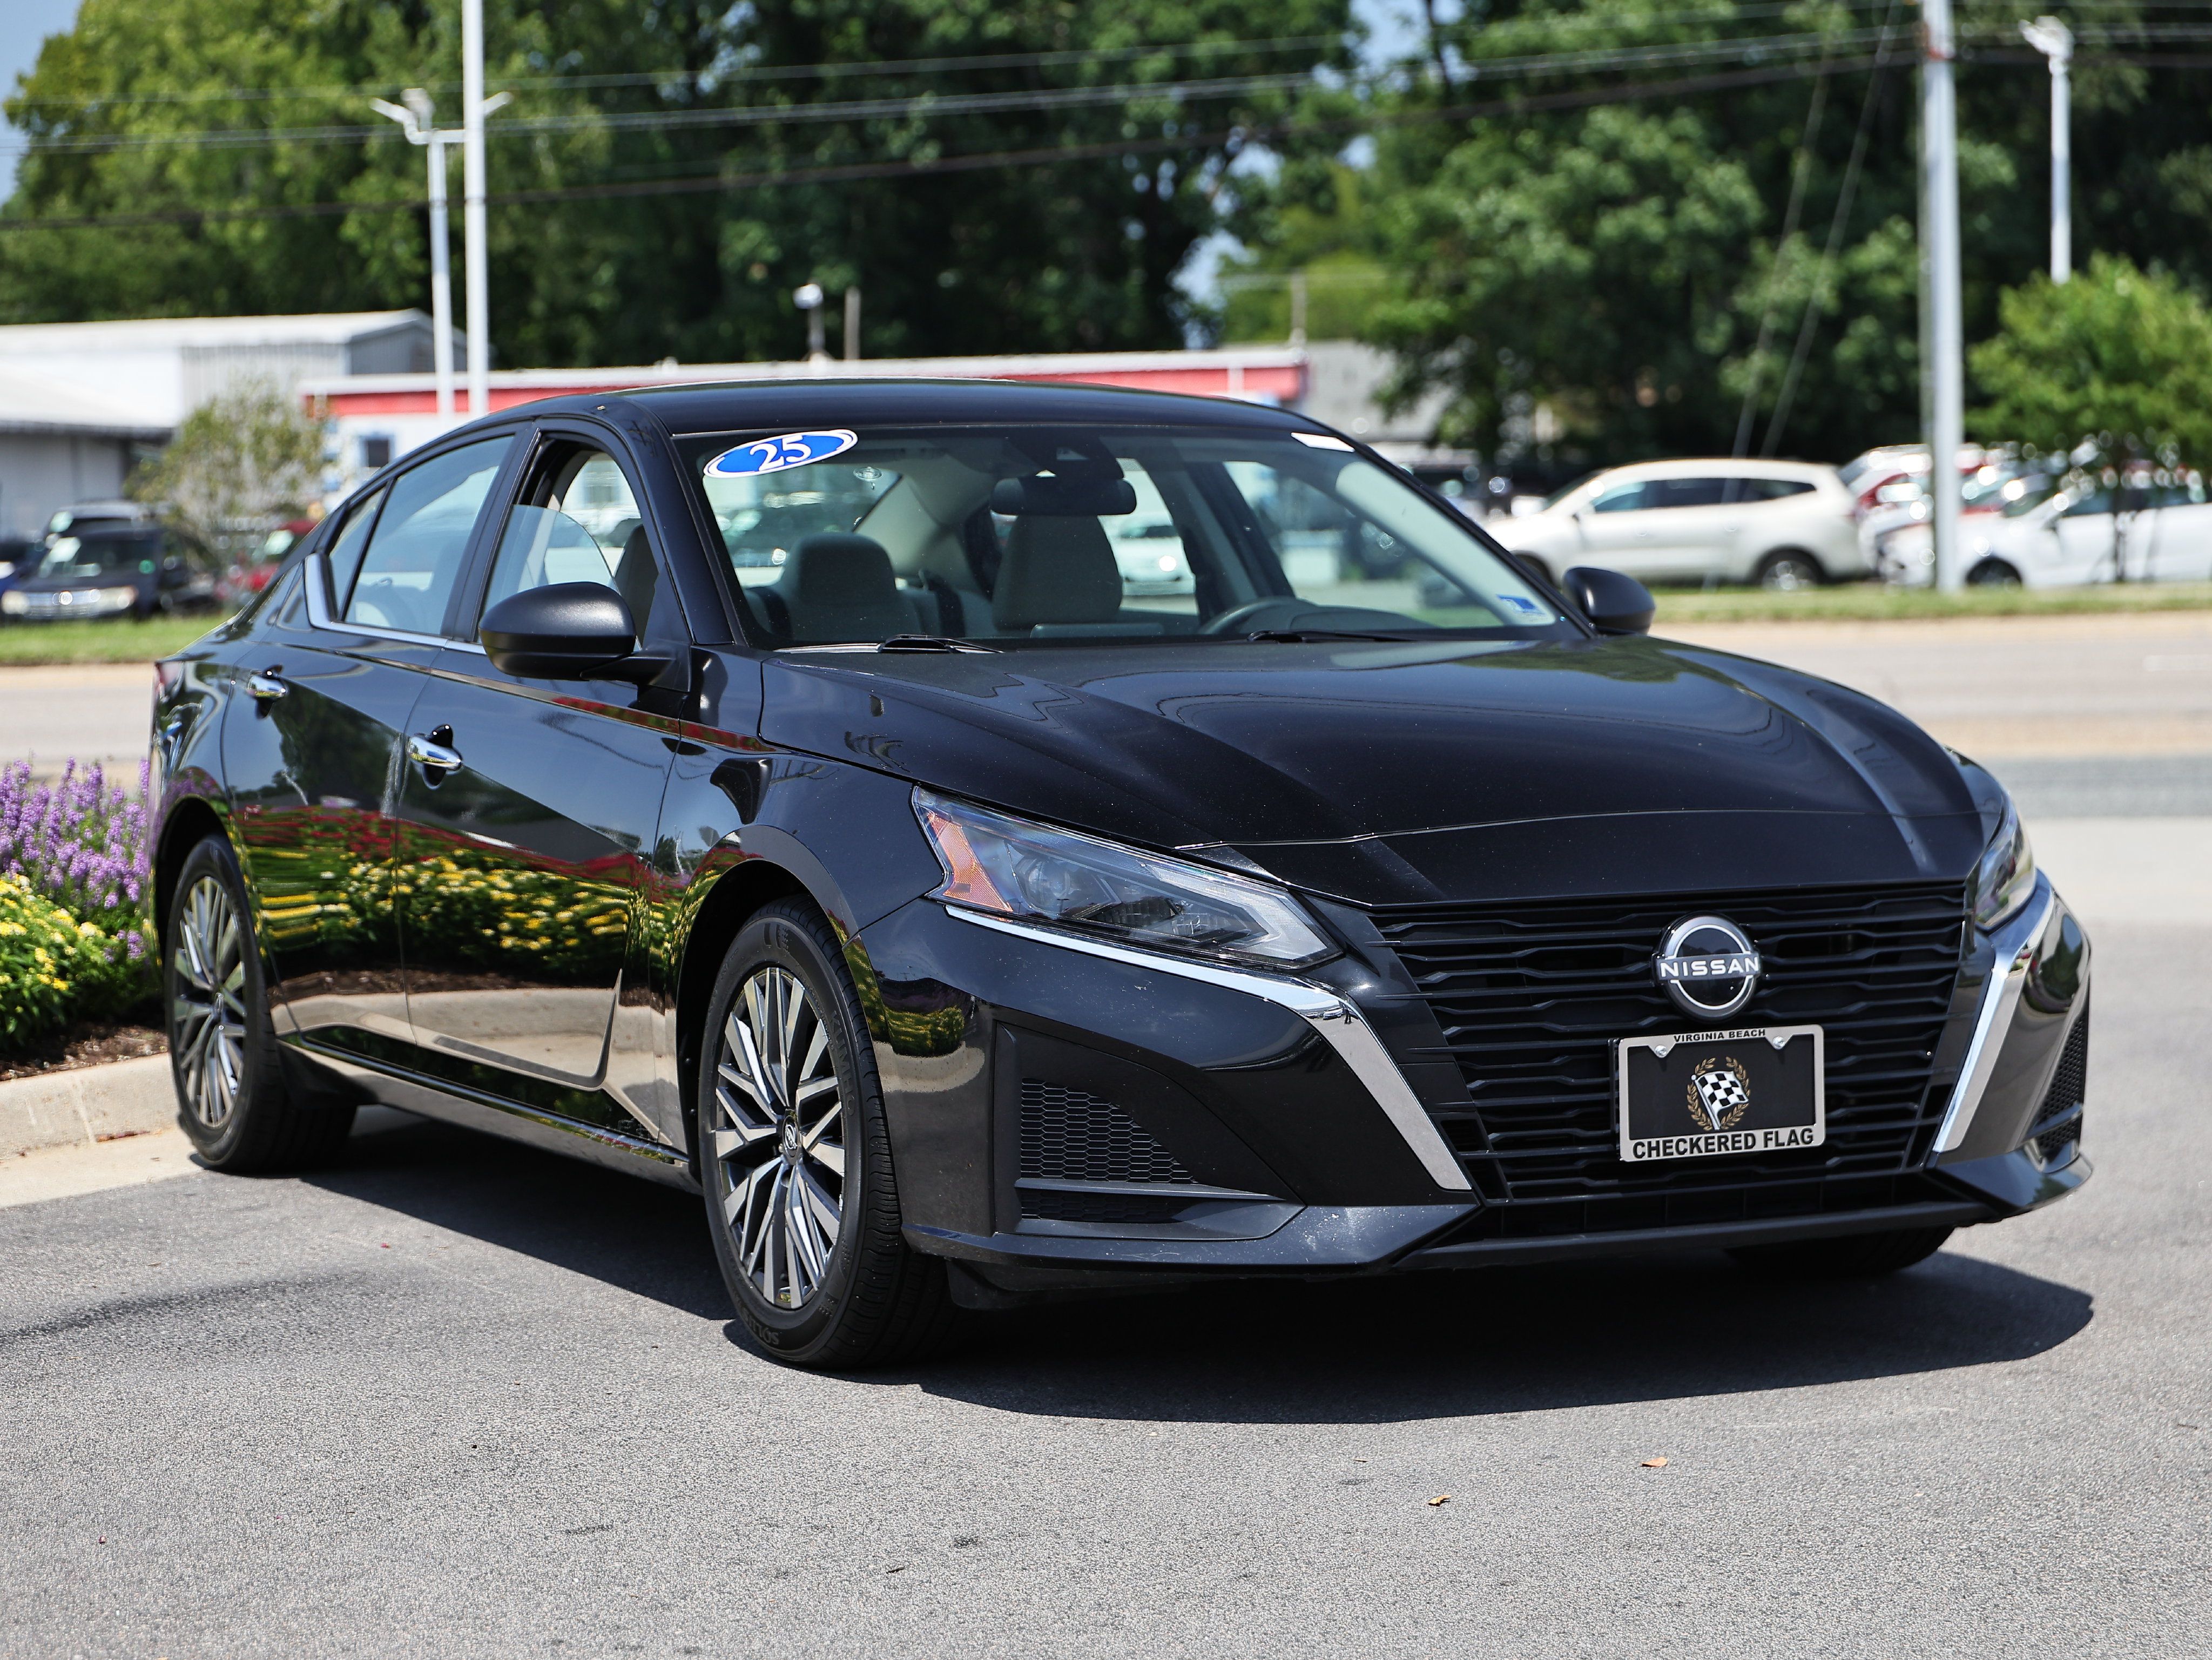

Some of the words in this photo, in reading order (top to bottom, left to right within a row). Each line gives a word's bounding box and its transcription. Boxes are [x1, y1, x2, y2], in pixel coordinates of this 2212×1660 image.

[750, 435, 811, 471] 25
[1661, 956, 1758, 977] NISSAN
[1674, 1032, 1724, 1043] VIRGINIA
[1729, 1029, 1765, 1038] BEACH
[830, 1010, 855, 1116] KUMHO
[1632, 1133, 1757, 1159] CHECKERED
[1763, 1127, 1813, 1148] FLAG
